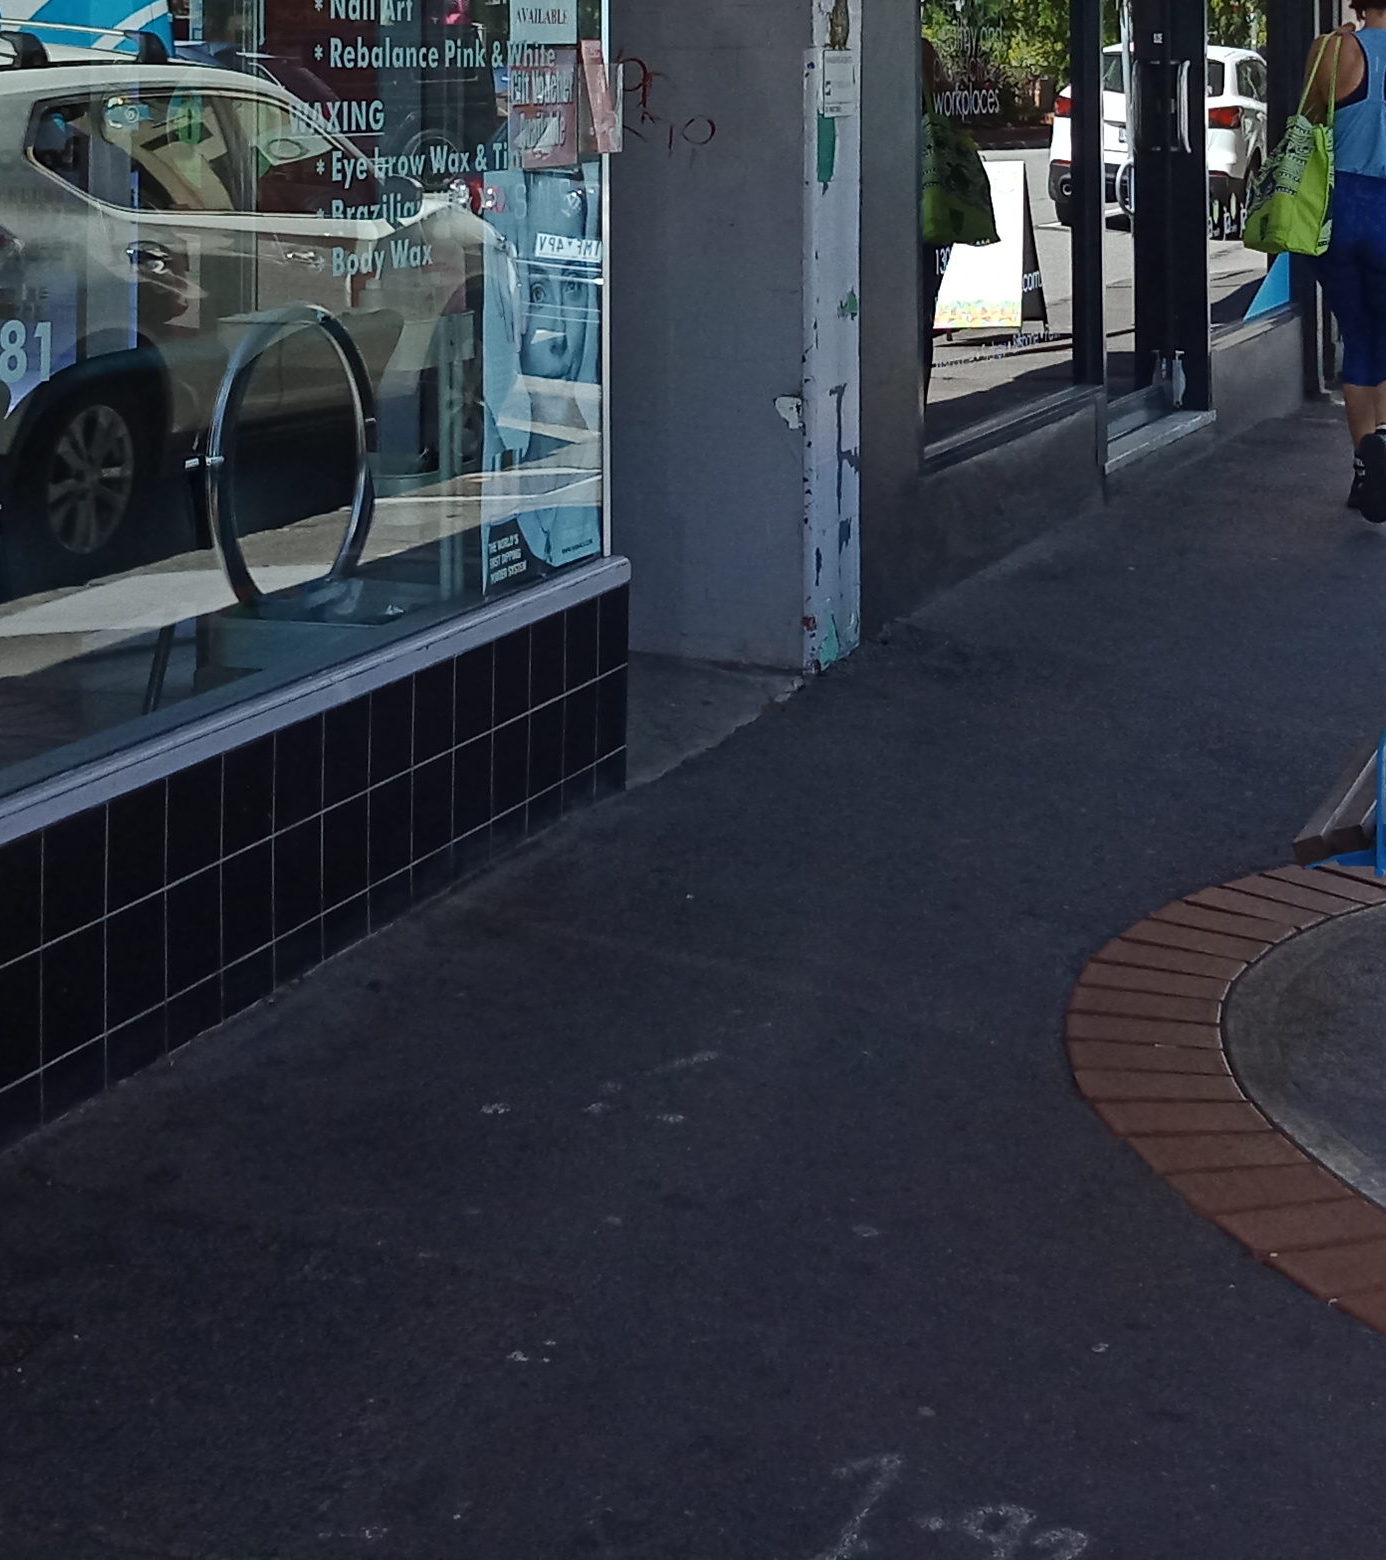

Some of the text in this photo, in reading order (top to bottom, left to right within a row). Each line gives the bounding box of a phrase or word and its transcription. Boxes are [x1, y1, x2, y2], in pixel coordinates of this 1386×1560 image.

[515, 6, 569, 25] AVAILABLE
[329, 37, 439, 68] Rebalance
[445, 39, 486, 68] Pink
[491, 41, 503, 68] &
[289, 100, 384, 135] WAXING
[933, 81, 1000, 123] workplaces
[331, 150, 367, 181] Eye
[430, 143, 469, 174] Wax
[475, 144, 487, 171] &
[331, 199, 423, 226] Brazilia
[332, 239, 432, 278] Body Wax
